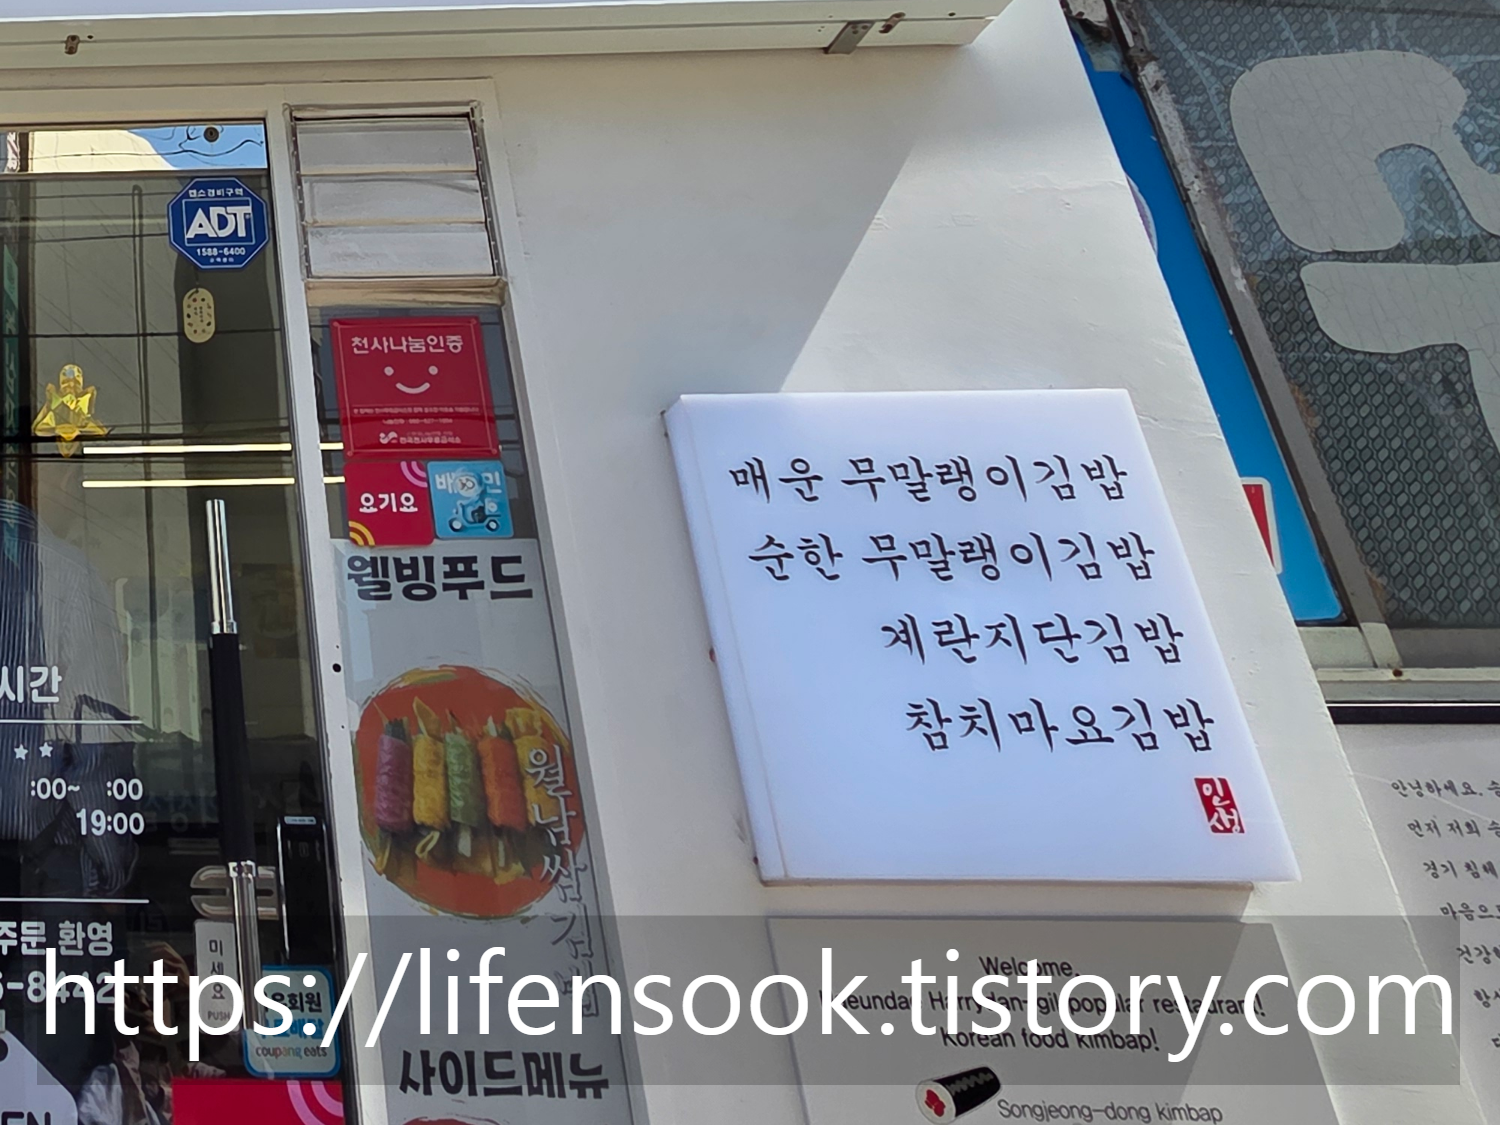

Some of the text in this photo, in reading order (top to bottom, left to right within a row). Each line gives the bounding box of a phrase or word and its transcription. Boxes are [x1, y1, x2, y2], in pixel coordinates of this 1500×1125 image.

[186, 206, 252, 238] ADT
[197, 248, 246, 256] 1588-6400
[351, 334, 464, 355] 천사나눔인증
[729, 454, 1128, 503] 매운 무말랭이김밥
[359, 492, 419, 513] 요기요
[748, 531, 1155, 582] 순한 무말랭이김밥
[347, 555, 533, 601] 웰빙푸드
[881, 613, 1184, 665] 계란지단김밥
[906, 697, 1215, 753] 참치마요김밥
[76, 808, 145, 836] 19:00
[1200, 778, 1242, 833] 인생
[1407, 819, 1442, 838] 먼저
[58, 920, 113, 956] 환영
[209, 939, 226, 1000] 미세요
[256, 1046, 303, 1059] coupang
[940, 1027, 1016, 1048] Korean
[1021, 1028, 1070, 1049] food
[399, 1049, 610, 1100] 사이드메뉴
[1155, 1101, 1223, 1124] kimbap
